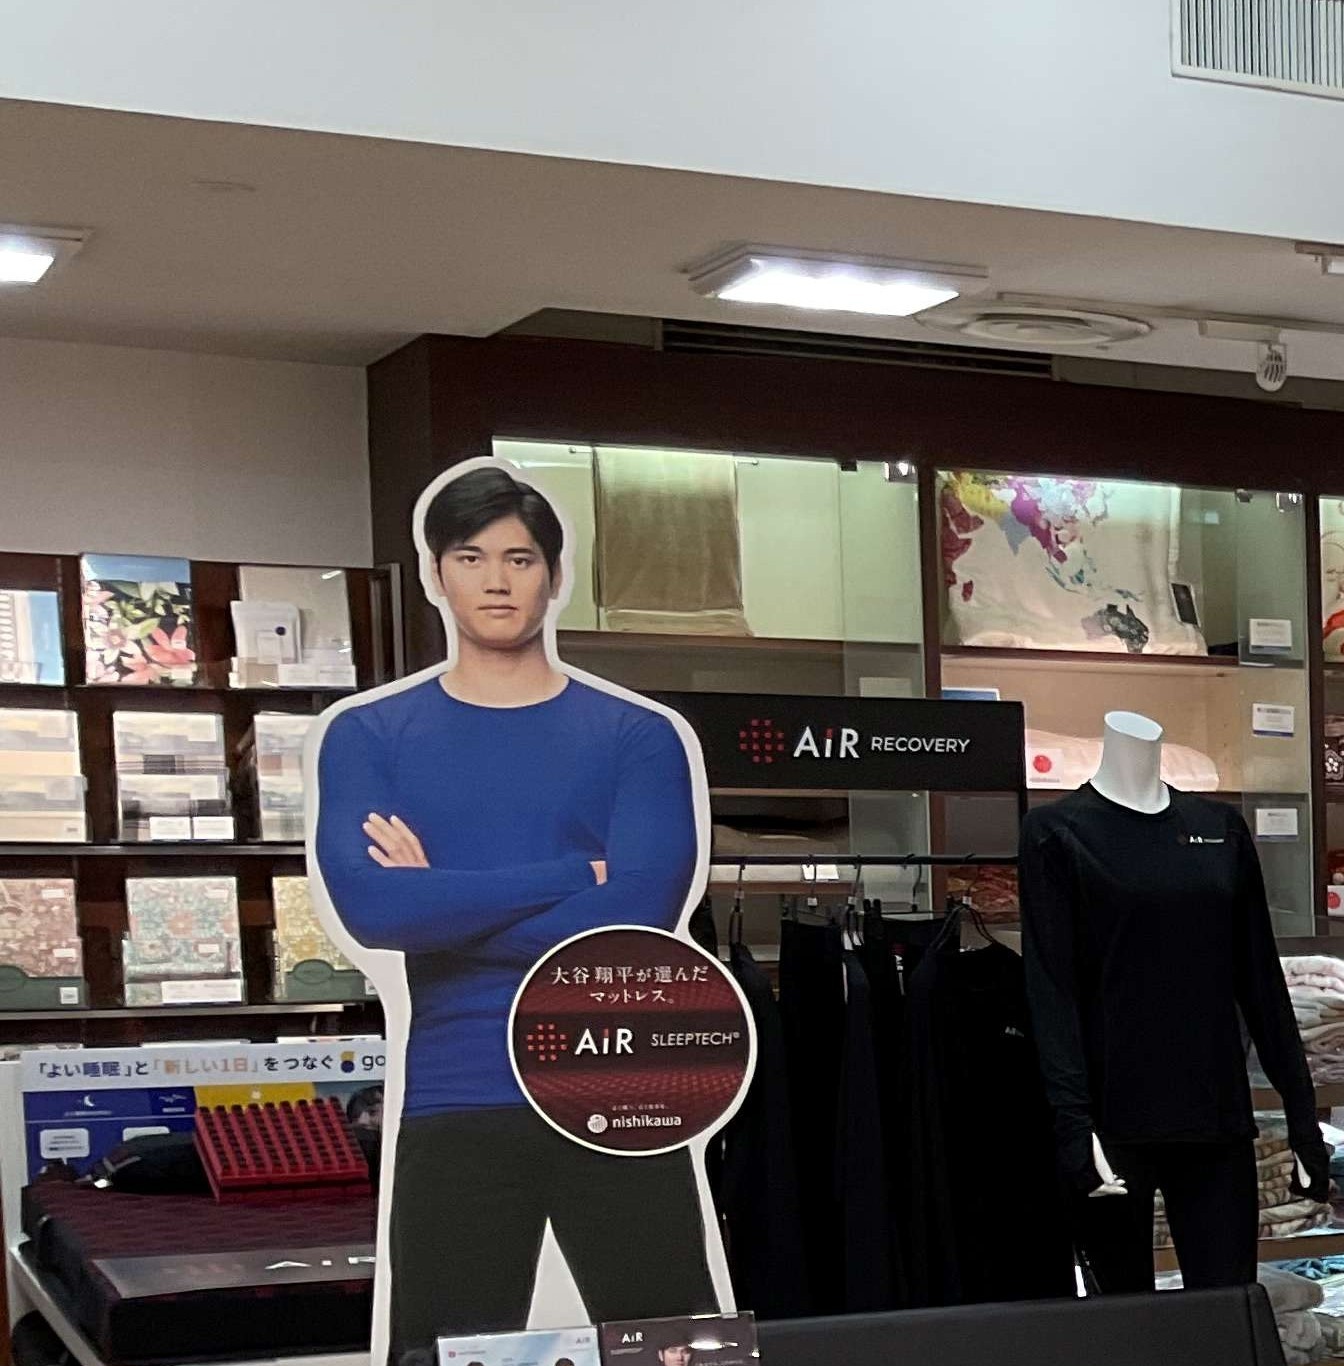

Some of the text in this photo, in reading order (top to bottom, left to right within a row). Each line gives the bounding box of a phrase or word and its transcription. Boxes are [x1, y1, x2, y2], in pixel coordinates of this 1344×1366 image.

[871, 735, 970, 754] RECOVERY
[551, 965, 709, 985] 大谷翔平が選んだ
[590, 989, 674, 1004] マットレス。
[612, 1115, 682, 1128] nishikawa
